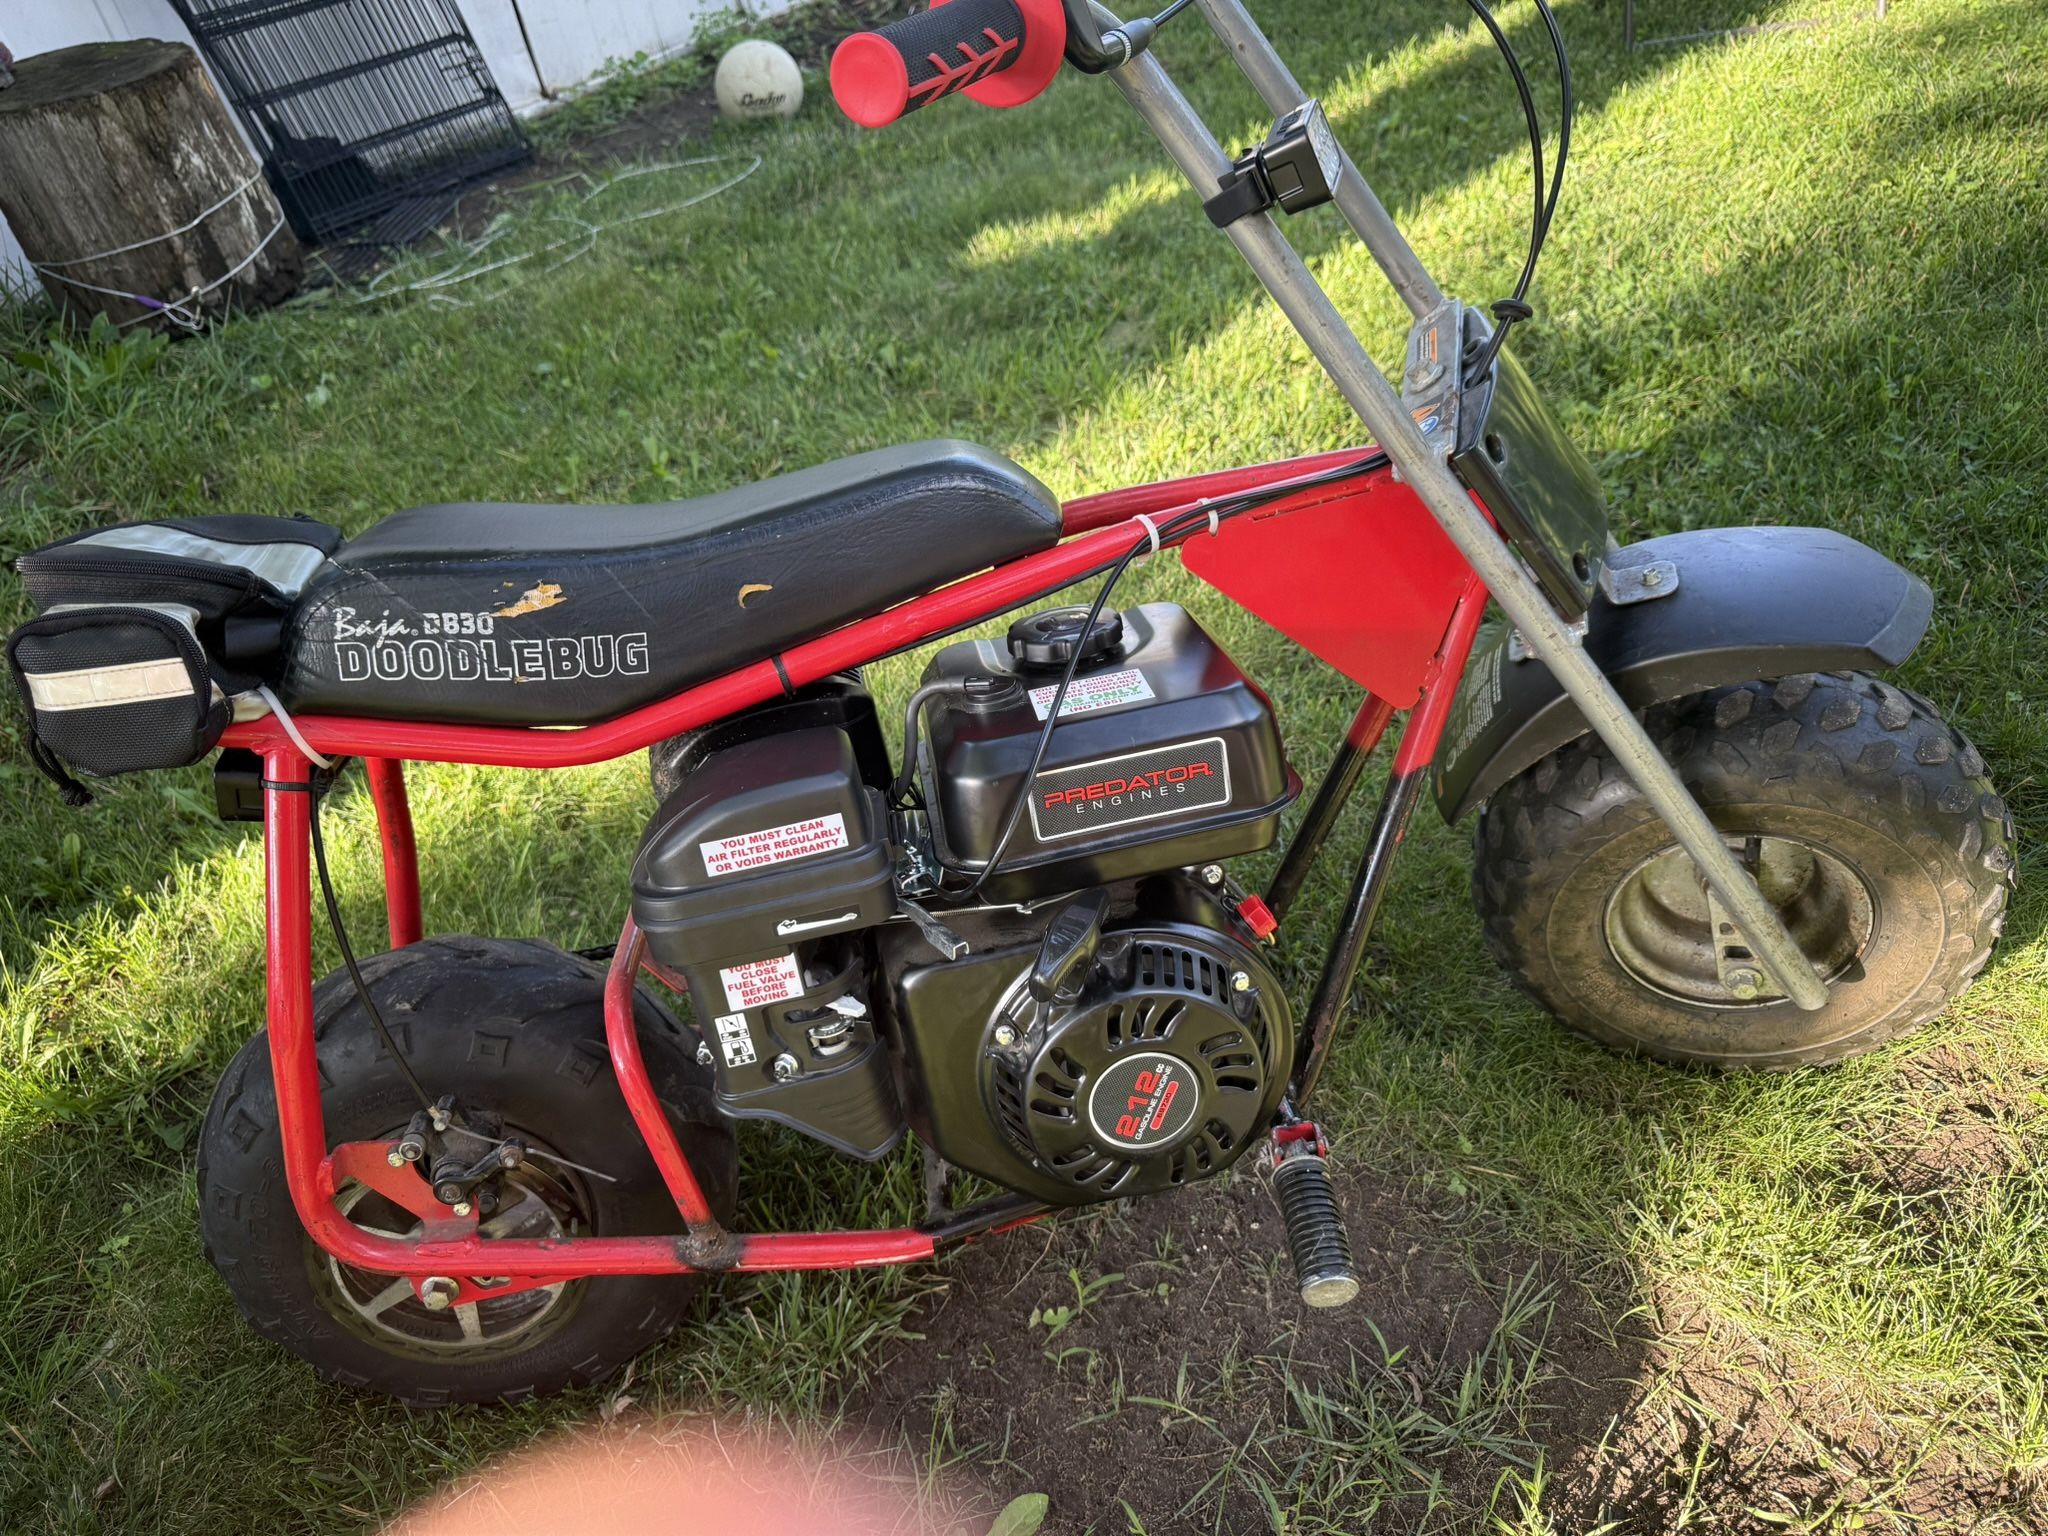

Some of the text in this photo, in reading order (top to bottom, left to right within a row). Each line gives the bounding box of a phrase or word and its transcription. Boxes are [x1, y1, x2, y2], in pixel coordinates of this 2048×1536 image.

[333, 631, 649, 682] DOODLEBUG
[1088, 685, 1140, 700] ONLY
[1044, 761, 1213, 809] PREDATOR
[1075, 782, 1186, 814] ENGINES
[707, 826, 843, 864] AIR FILTER REGULARLY
[720, 819, 824, 850] YOU MUST CLEAN
[715, 837, 840, 873] OR VOIDS WARRANTY
[727, 970, 796, 992] FUEL VALVE
[740, 965, 778, 980] CLOSE
[741, 981, 787, 998] BEFORE
[743, 989, 789, 1007] MOVING
[1115, 1070, 1160, 1138] 212
[1134, 1064, 1173, 1140] GASOLINE ENGINE
